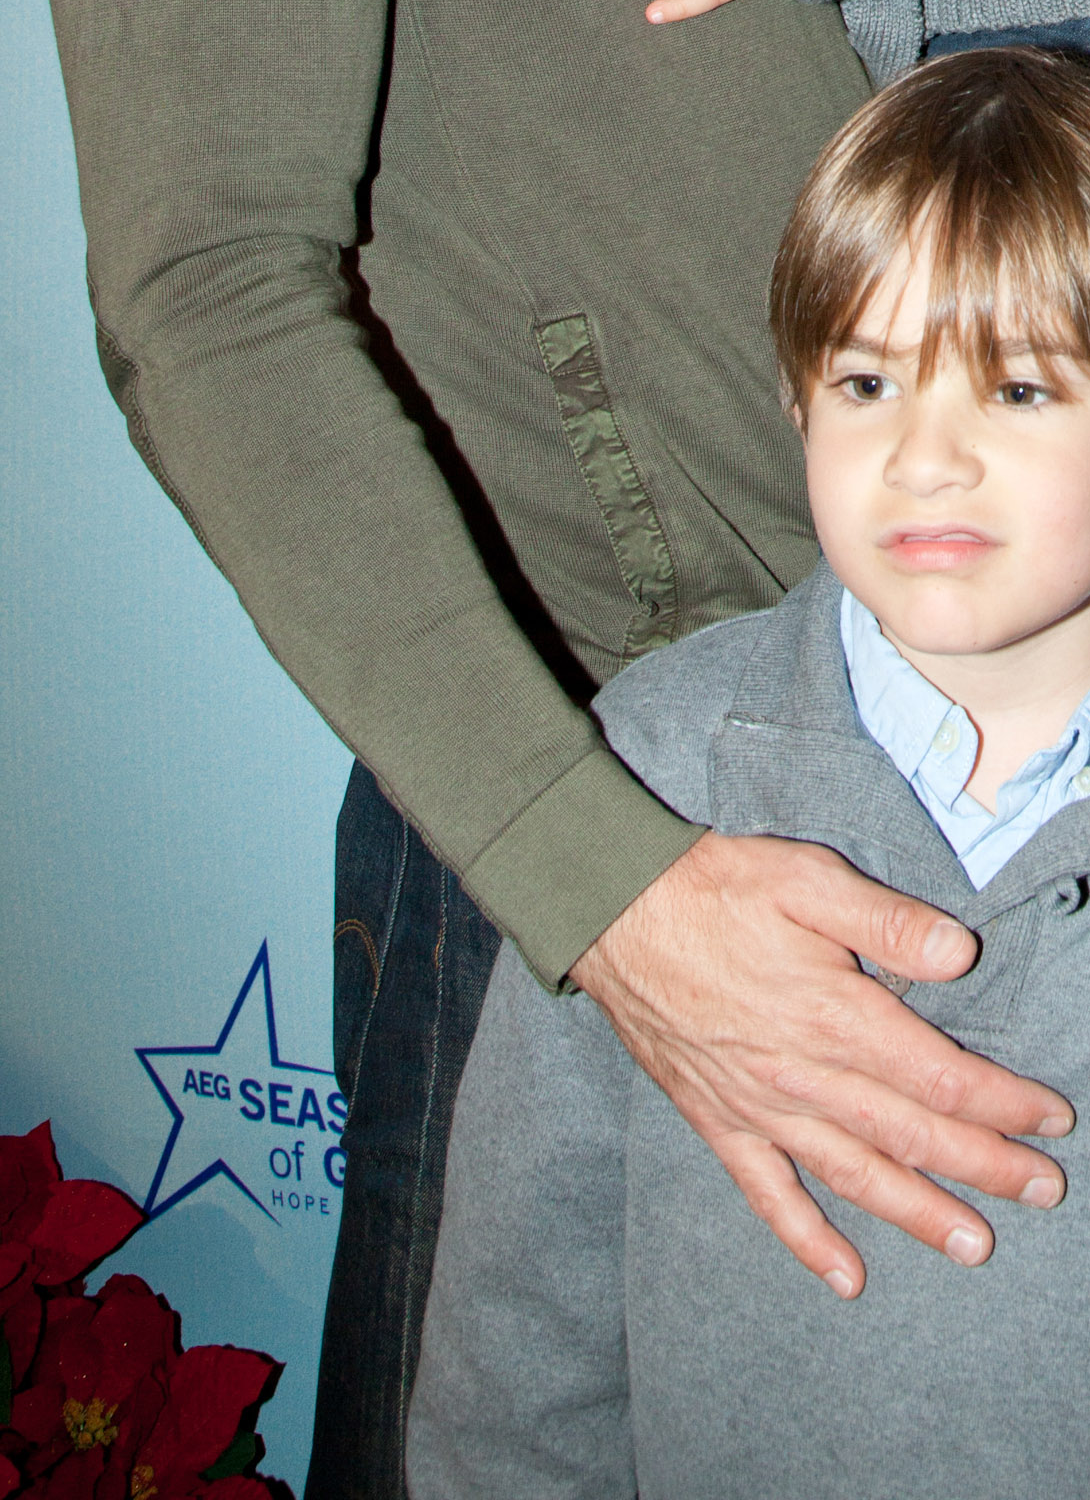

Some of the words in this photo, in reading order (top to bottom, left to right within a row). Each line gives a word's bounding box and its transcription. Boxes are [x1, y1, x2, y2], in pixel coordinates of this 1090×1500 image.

[183, 1069, 231, 1100] AEG
[269, 1140, 305, 1181] of
[272, 1188, 330, 1215] HOPE
